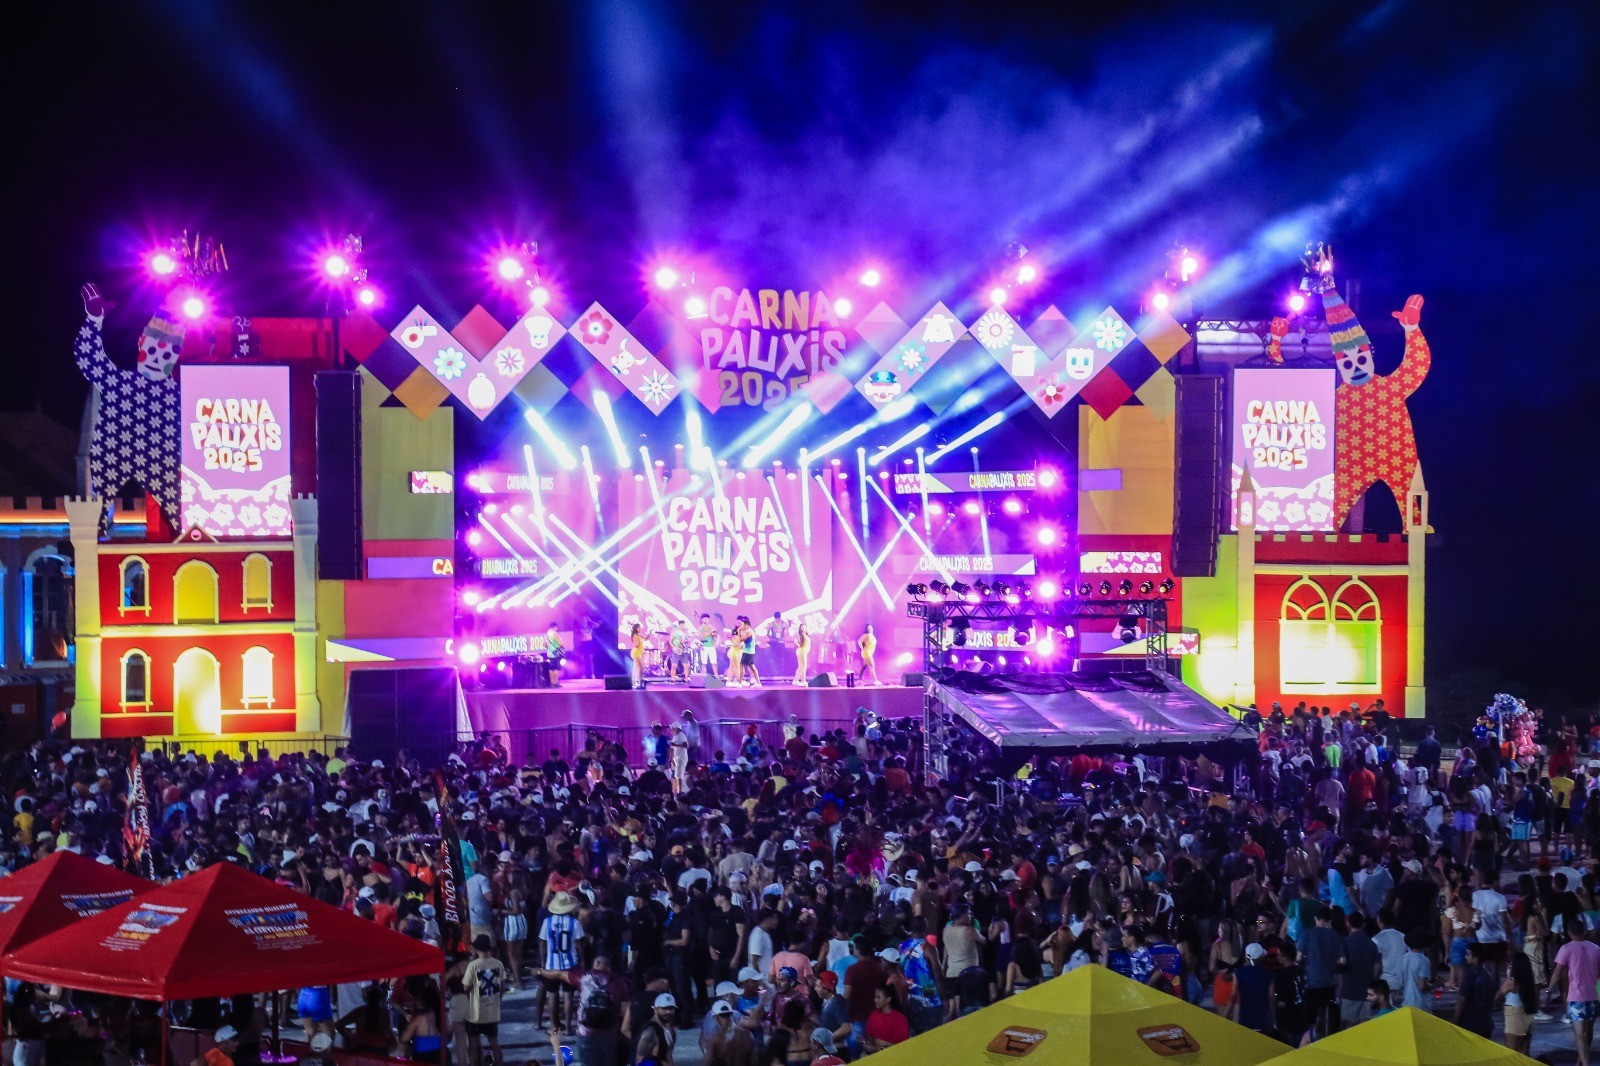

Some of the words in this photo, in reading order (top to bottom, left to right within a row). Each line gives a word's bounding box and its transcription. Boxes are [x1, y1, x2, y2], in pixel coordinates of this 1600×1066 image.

[709, 286, 839, 331] CARNA
[195, 398, 276, 424] CARNA
[1246, 400, 1321, 425] CARNA
[203, 447, 263, 474] 2025
[1252, 447, 1308, 471] 2025
[1016, 472, 1036, 487] 2025
[669, 496, 783, 533] CARNA
[520, 559, 538, 574] 2025
[973, 557, 993, 571] 2025
[680, 569, 763, 606] 2025
[551, 931, 571, 954] 10
